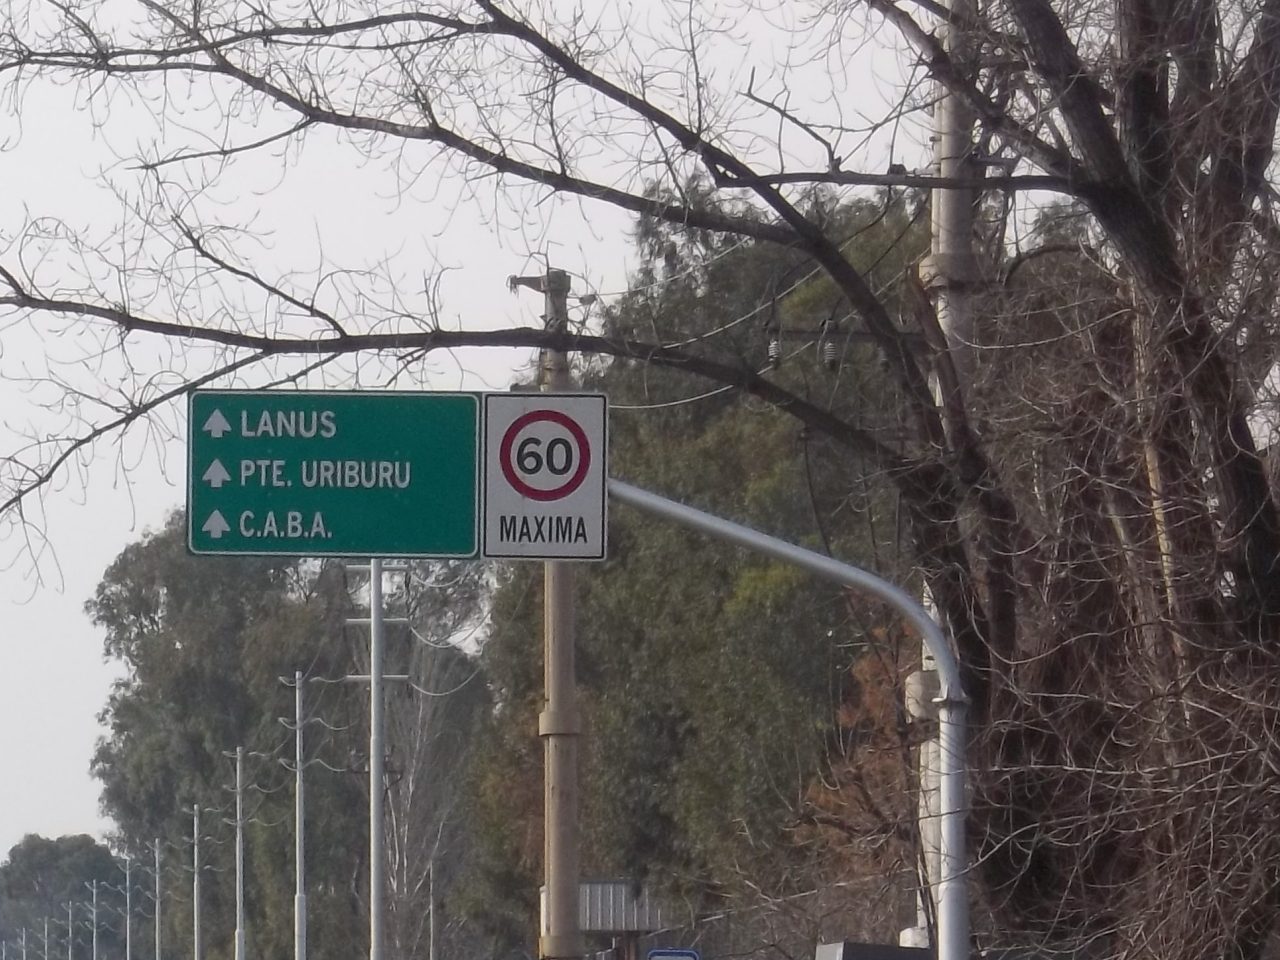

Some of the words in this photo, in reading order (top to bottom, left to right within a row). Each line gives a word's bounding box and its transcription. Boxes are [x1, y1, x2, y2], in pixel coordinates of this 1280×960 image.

[240, 410, 337, 438] LANUS
[516, 437, 573, 475] 60
[239, 460, 292, 488] PTE.
[301, 460, 411, 489] URIBURU
[239, 510, 333, 538] C.A.B.A.
[499, 515, 588, 543] MAXIMA
